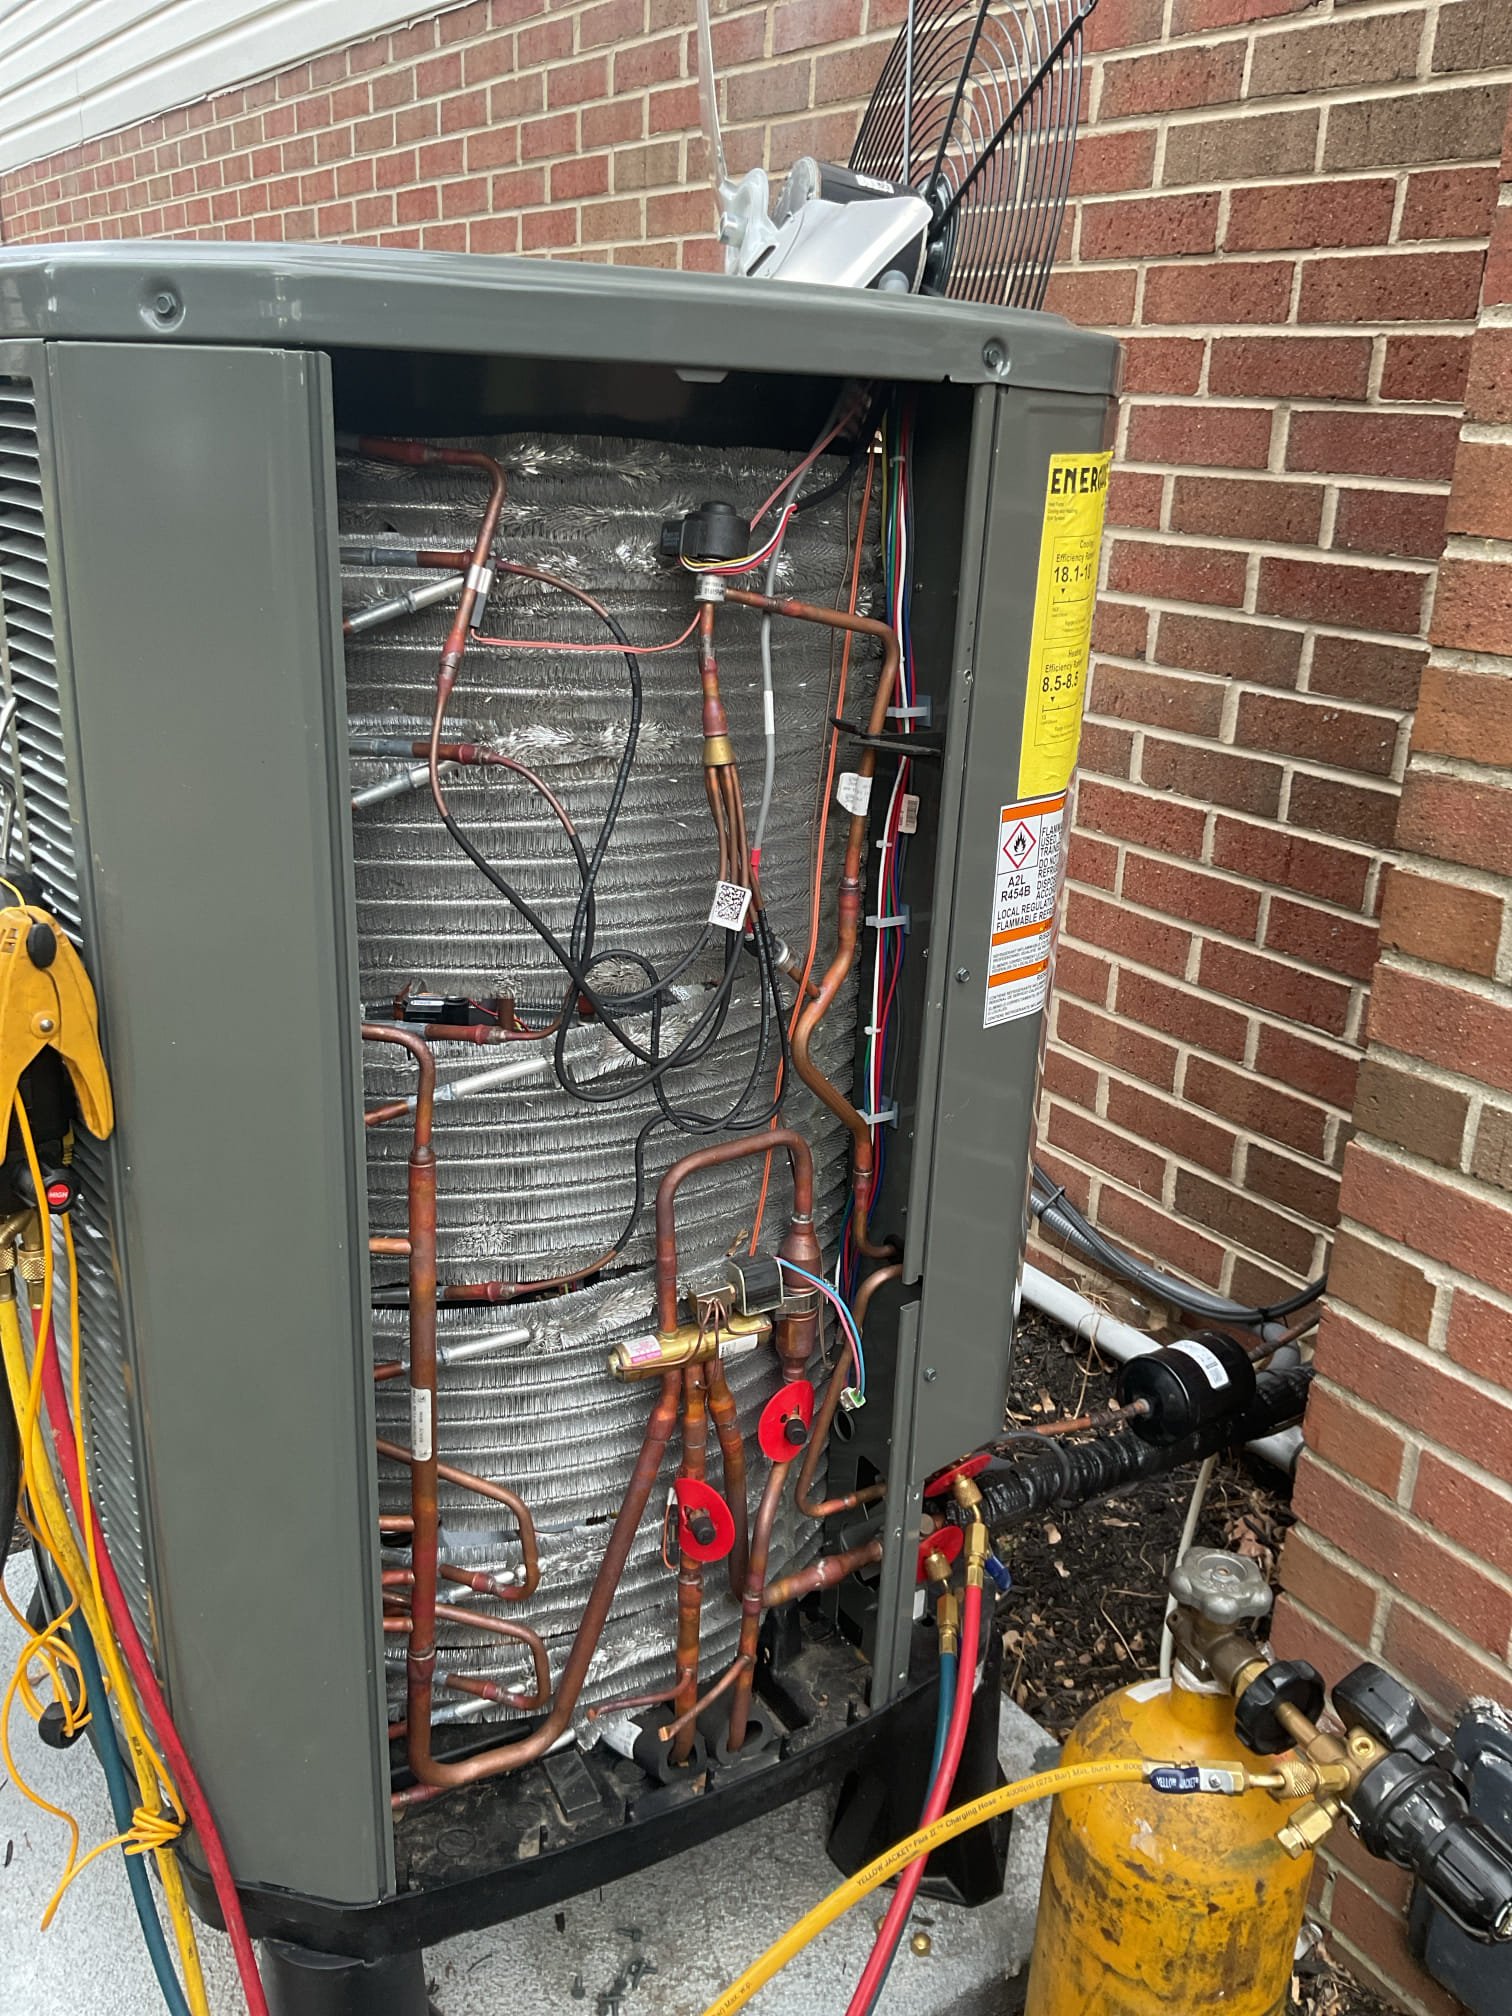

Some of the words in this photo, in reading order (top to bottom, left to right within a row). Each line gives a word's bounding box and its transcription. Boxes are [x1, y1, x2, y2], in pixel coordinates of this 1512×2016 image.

[1056, 553, 1084, 564] Efficiency
[1045, 662, 1072, 674] Efficiency
[1039, 858, 1048, 869] DO
[1007, 874, 1026, 889] A2L
[1000, 885, 1031, 902] R454B
[997, 906, 1020, 921] LOCAL
[996, 912, 1037, 932] FLAMMABLE
[47, 1191, 69, 1199] HIGH
[1155, 1776, 1178, 1789] YELLOW
[856, 1862, 884, 1887] YELLOW
[913, 1834, 929, 1849] Plus
[945, 1807, 978, 1828] Charging
[977, 1798, 997, 1812] Hose
